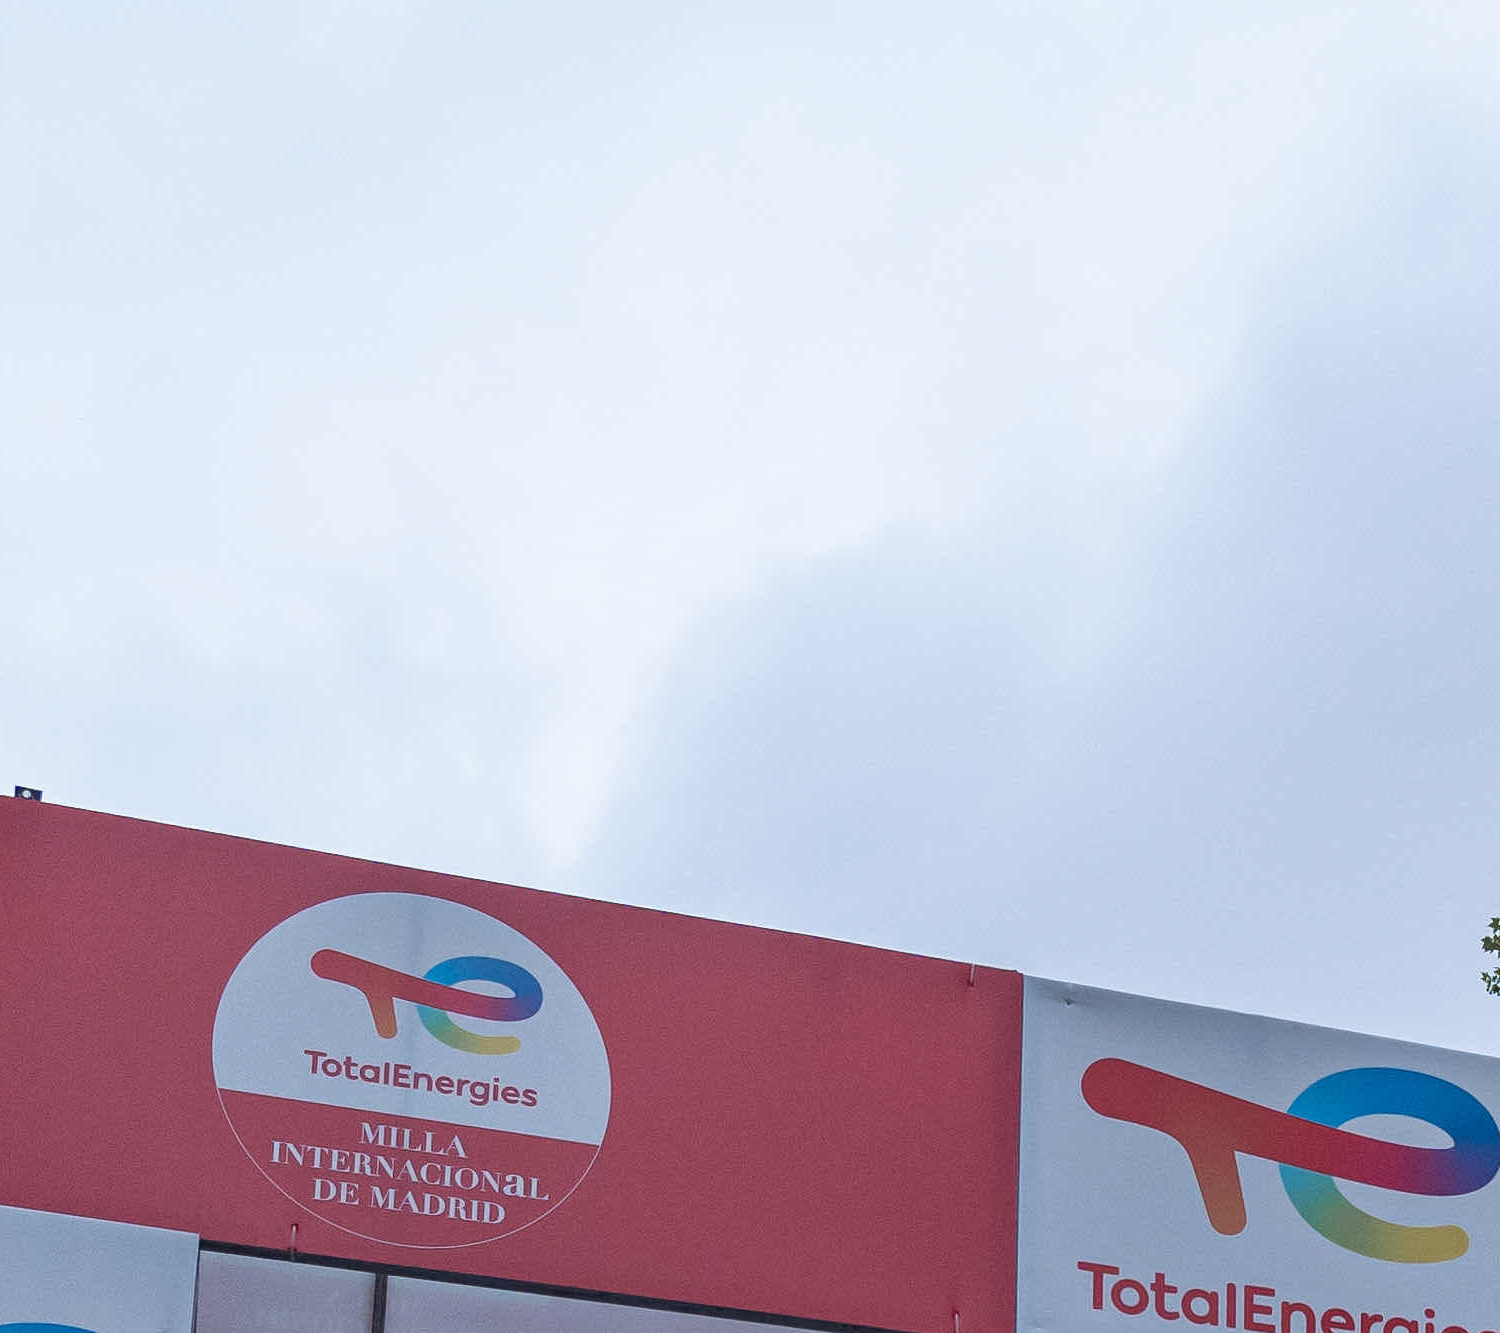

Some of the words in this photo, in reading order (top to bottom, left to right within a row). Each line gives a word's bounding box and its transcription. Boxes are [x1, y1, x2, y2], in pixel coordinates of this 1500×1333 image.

[304, 1049, 538, 1107] TotalEnergies
[359, 1121, 467, 1159] MILLA
[312, 1177, 361, 1206] DE
[370, 1185, 506, 1225] MADRID
